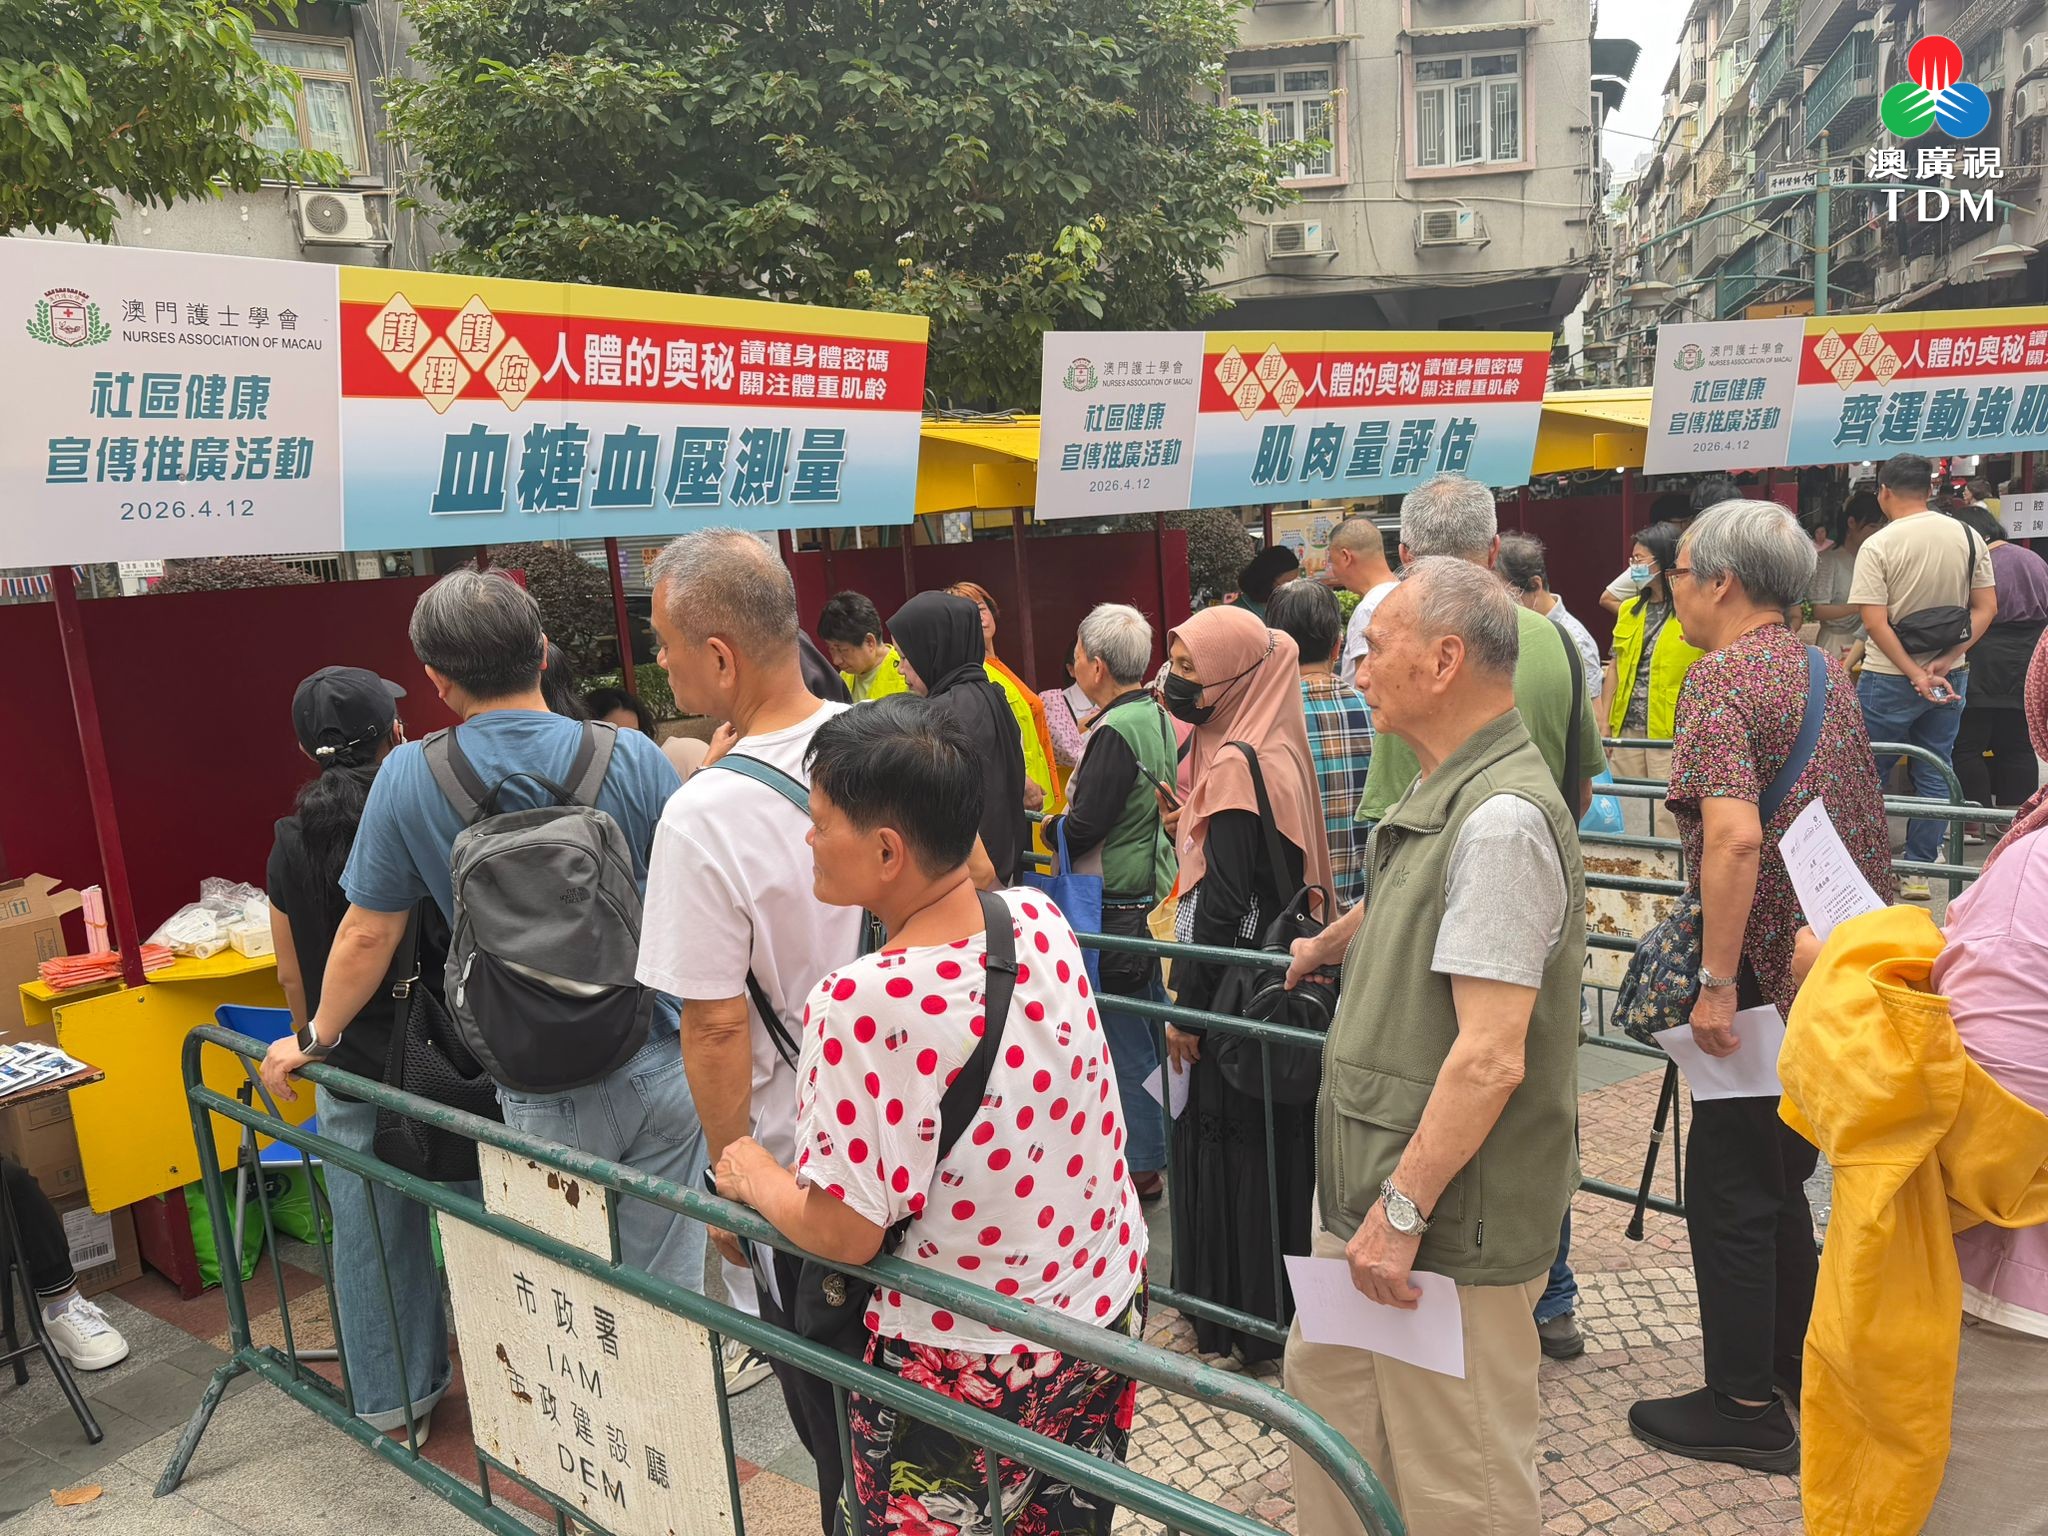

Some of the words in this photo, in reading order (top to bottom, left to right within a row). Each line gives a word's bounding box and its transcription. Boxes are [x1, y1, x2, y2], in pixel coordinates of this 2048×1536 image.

[122, 299, 299, 331] 澳門護士學會
[123, 330, 175, 345] NURSES
[179, 332, 259, 348] ASSOCIATION
[262, 335, 279, 348] OF
[281, 336, 323, 350] MACAU
[740, 339, 889, 373] 讀懂身體密碼
[1709, 342, 1784, 358] 澳門護士學會
[1902, 334, 2026, 370] 人體的奧秘
[542, 331, 735, 391] 人體的奧秘
[1103, 360, 1183, 376] 澳門護士學會
[1423, 358, 1523, 376] 讀懂身體密碼
[1731, 358, 1766, 366] ASSOCIATION
[1766, 357, 1774, 365] OF
[1774, 356, 1793, 364] MACAU
[739, 371, 887, 401] 關注體重肌齡
[1102, 379, 1126, 388] NURSES
[1127, 378, 1164, 387] ASSOCIATION
[1164, 378, 1173, 386] OF
[1173, 377, 1193, 386] MACAU
[1305, 361, 1420, 397] 人體的奧秘
[1420, 378, 1519, 398] 關注體重肌齡
[1690, 376, 1767, 404] 社區健康
[90, 371, 271, 420] 社區健康
[1084, 402, 1166, 432] 社區健康
[1667, 406, 1781, 435] 宣傳推廣活動
[1831, 384, 2048, 448] 齊運動強肌
[46, 436, 314, 484] 宣傳推廣活動
[1060, 438, 1182, 471] 宣傳推廣活動
[1250, 417, 1478, 487] 肌肉量評估
[1693, 440, 1750, 453] 2026.4.12
[430, 421, 847, 515] 血糖血壓測量
[1089, 478, 1150, 493] 2026.4.12
[120, 499, 255, 521] 2026.4.12
[513, 1271, 619, 1360] 市政署
[546, 1343, 602, 1399] IAM
[507, 1367, 670, 1489] 市政建設廳
[558, 1442, 626, 1509] DEM
